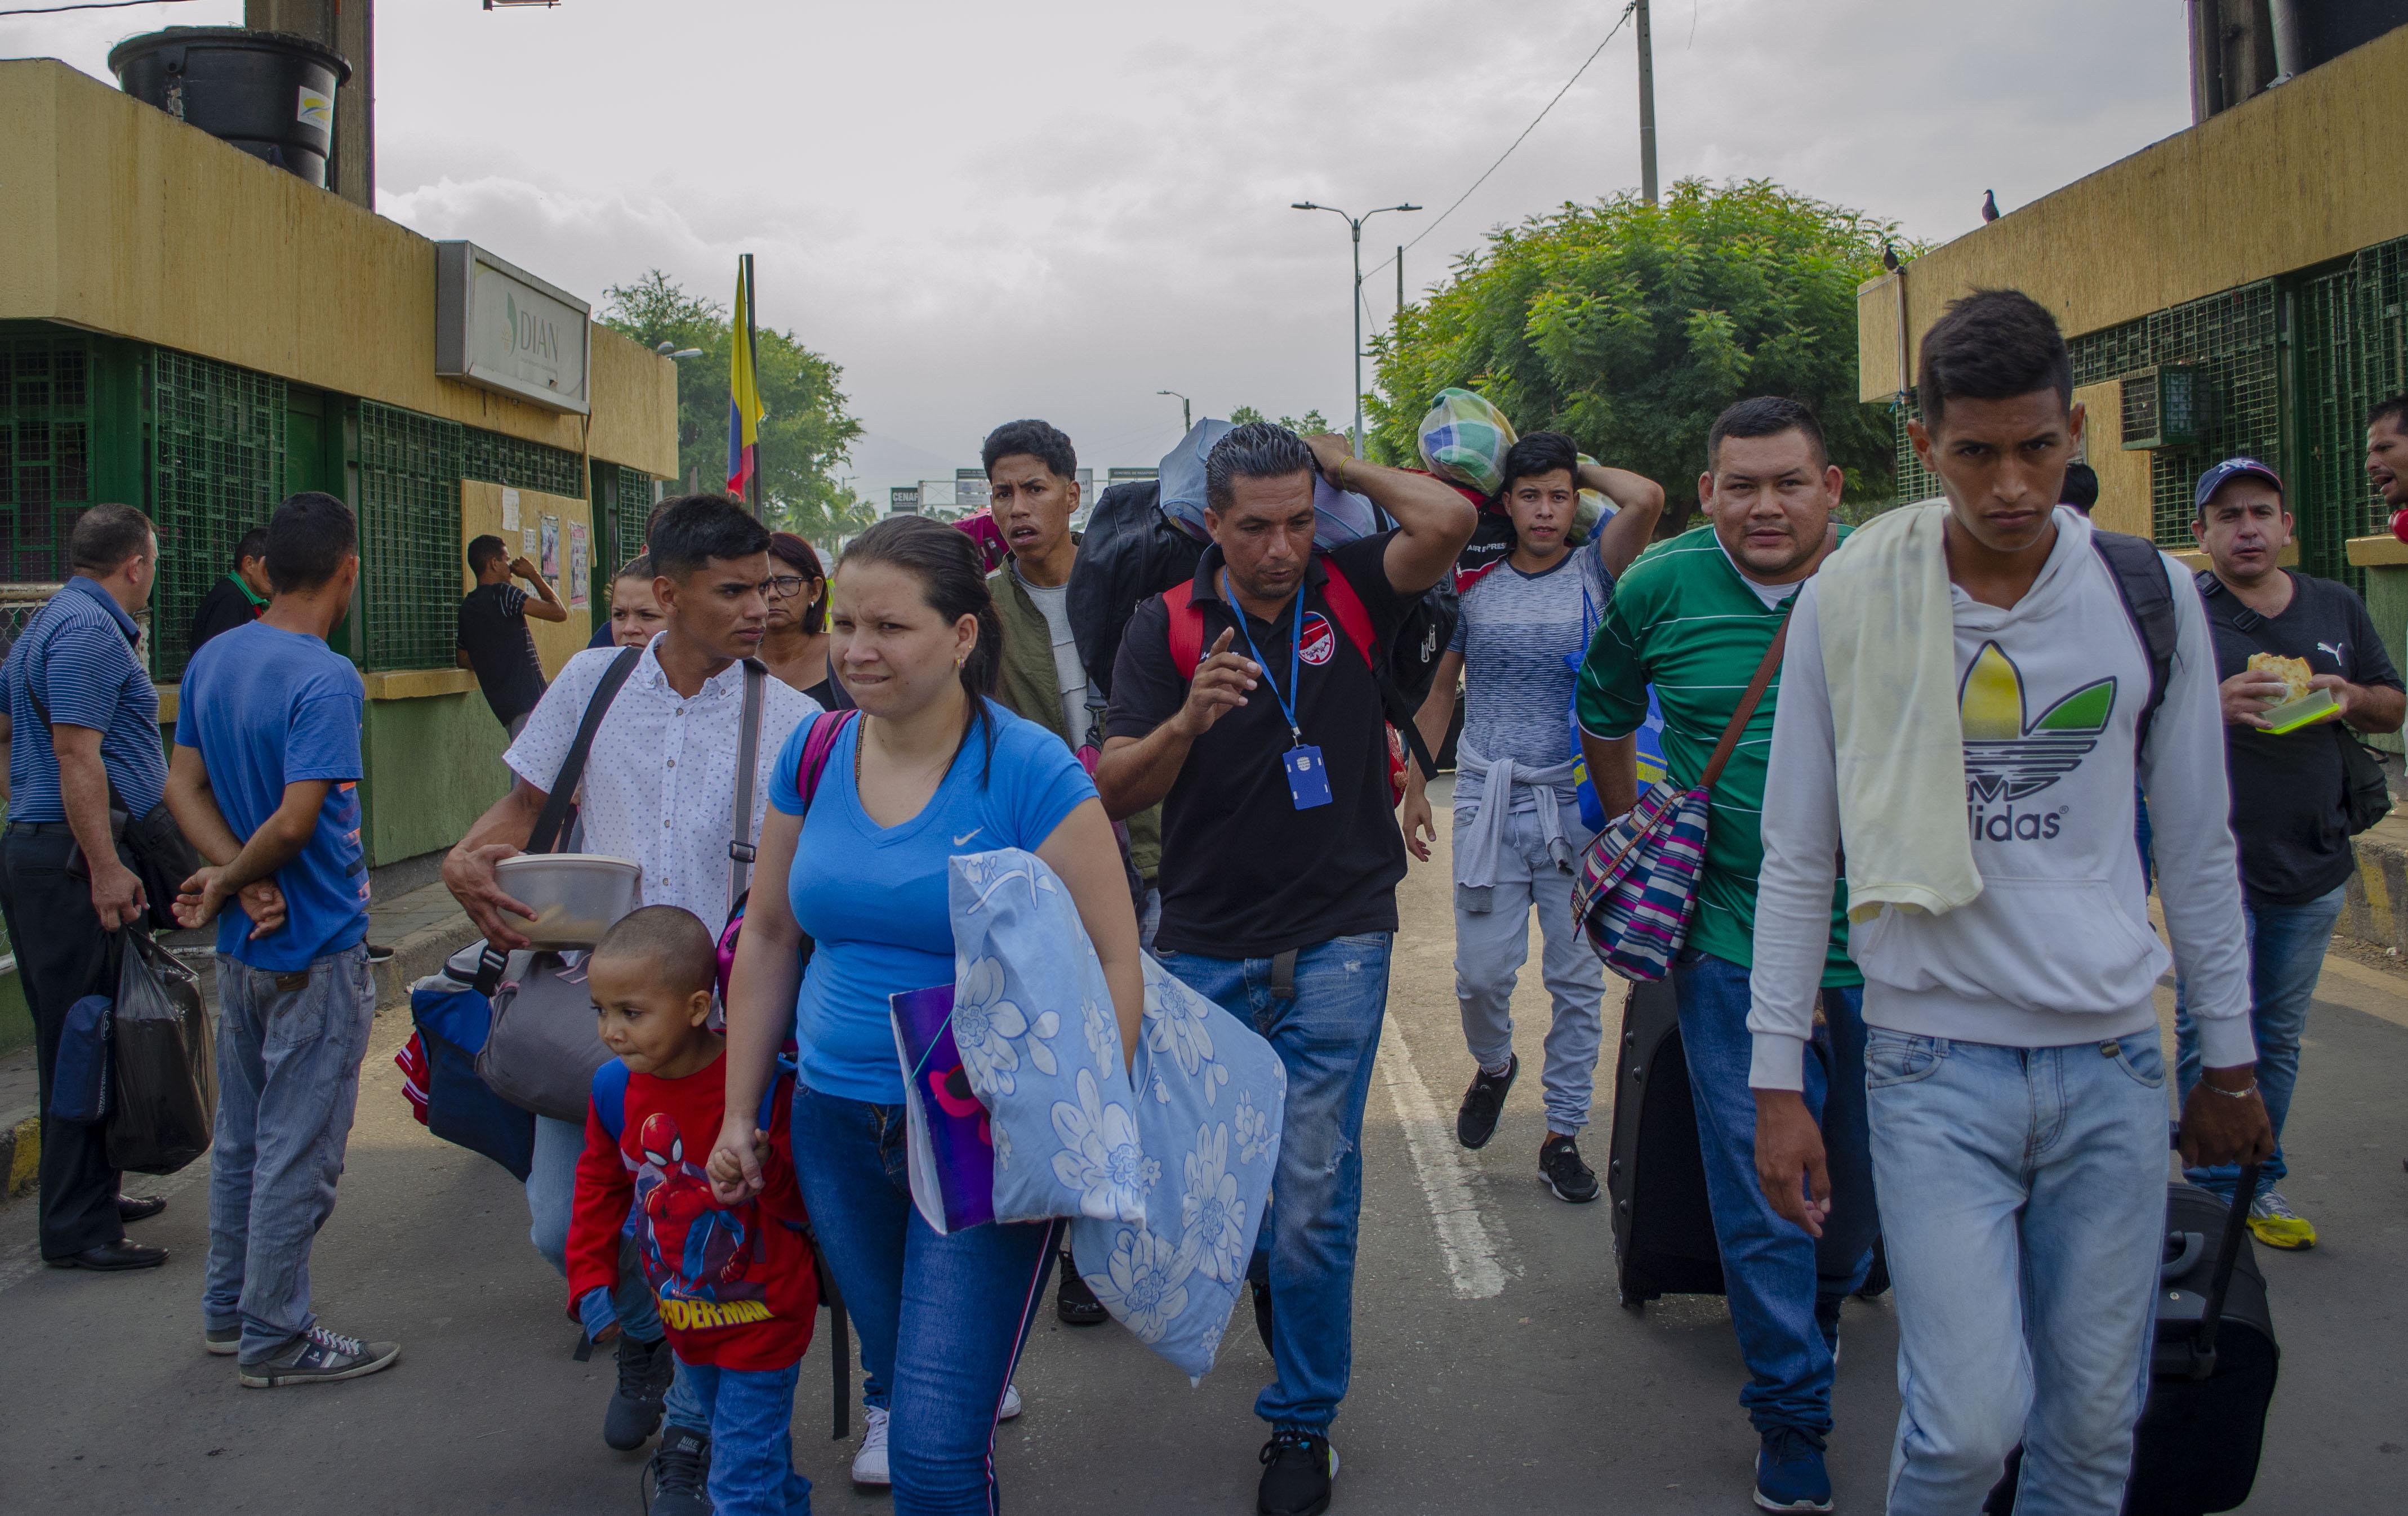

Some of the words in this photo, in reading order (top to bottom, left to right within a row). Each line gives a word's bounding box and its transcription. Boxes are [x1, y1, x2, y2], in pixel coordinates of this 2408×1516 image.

[520, 310, 559, 363] DIAN
[1466, 544, 1481, 553] AIR
[680, 1435, 700, 1449] NIKE
